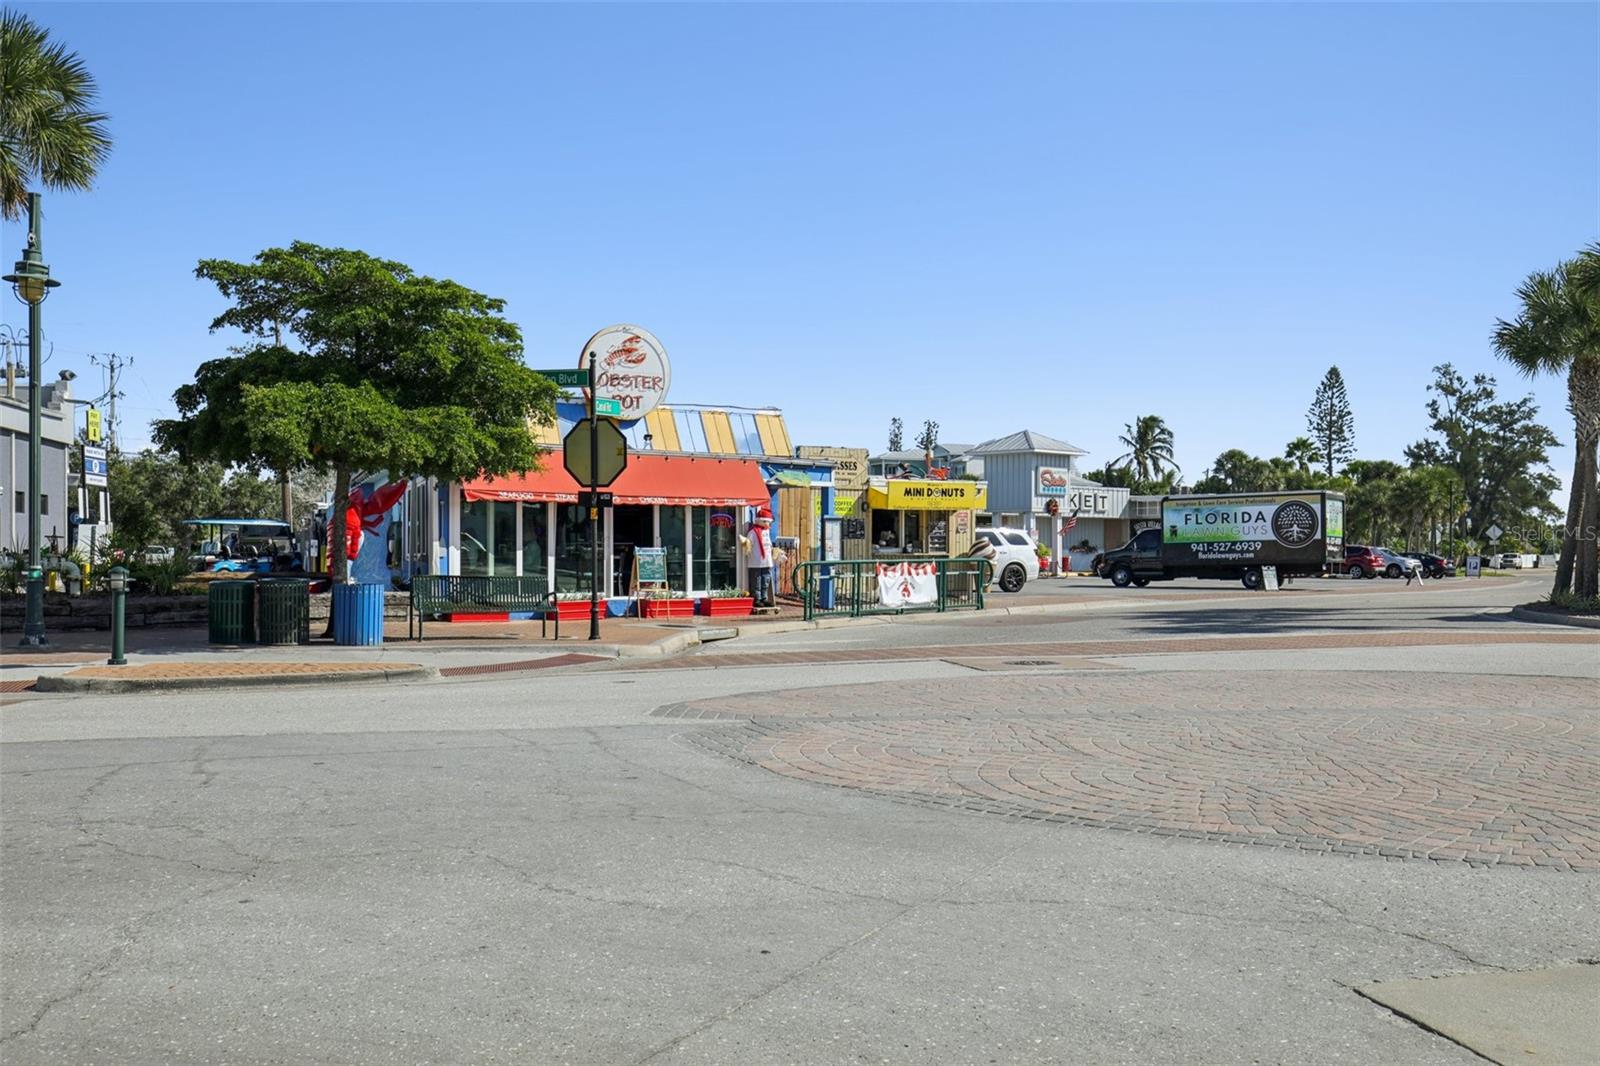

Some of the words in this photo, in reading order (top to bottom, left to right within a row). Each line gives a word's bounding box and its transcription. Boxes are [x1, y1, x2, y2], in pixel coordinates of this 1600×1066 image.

[559, 373, 577, 384] Blvd
[597, 373, 663, 391] OBSTER
[837, 461, 858, 471] SSES
[903, 487, 925, 498] MINI
[926, 487, 966, 499] DONUTS
[1184, 510, 1267, 525] FLORIDA
[1184, 526, 1225, 538] LAWN
[1230, 524, 1269, 536] GUYS
[1191, 541, 1262, 551] 941-527-6939
